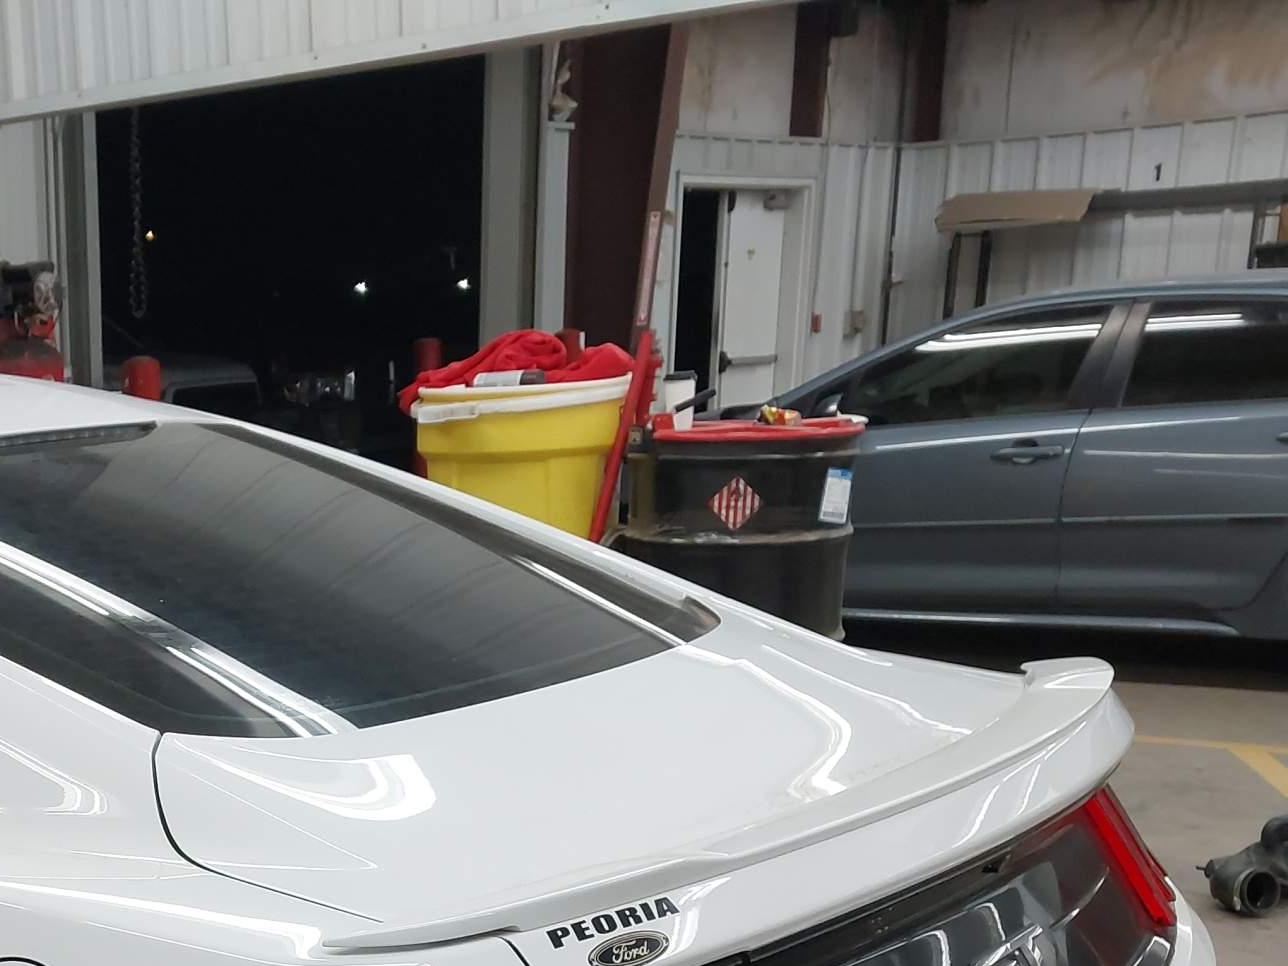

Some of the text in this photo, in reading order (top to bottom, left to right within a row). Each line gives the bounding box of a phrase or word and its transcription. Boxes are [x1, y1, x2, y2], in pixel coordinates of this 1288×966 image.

[1154, 162, 1162, 181] 1
[546, 897, 680, 949] PEORIA
[612, 940, 650, 964] Ford
